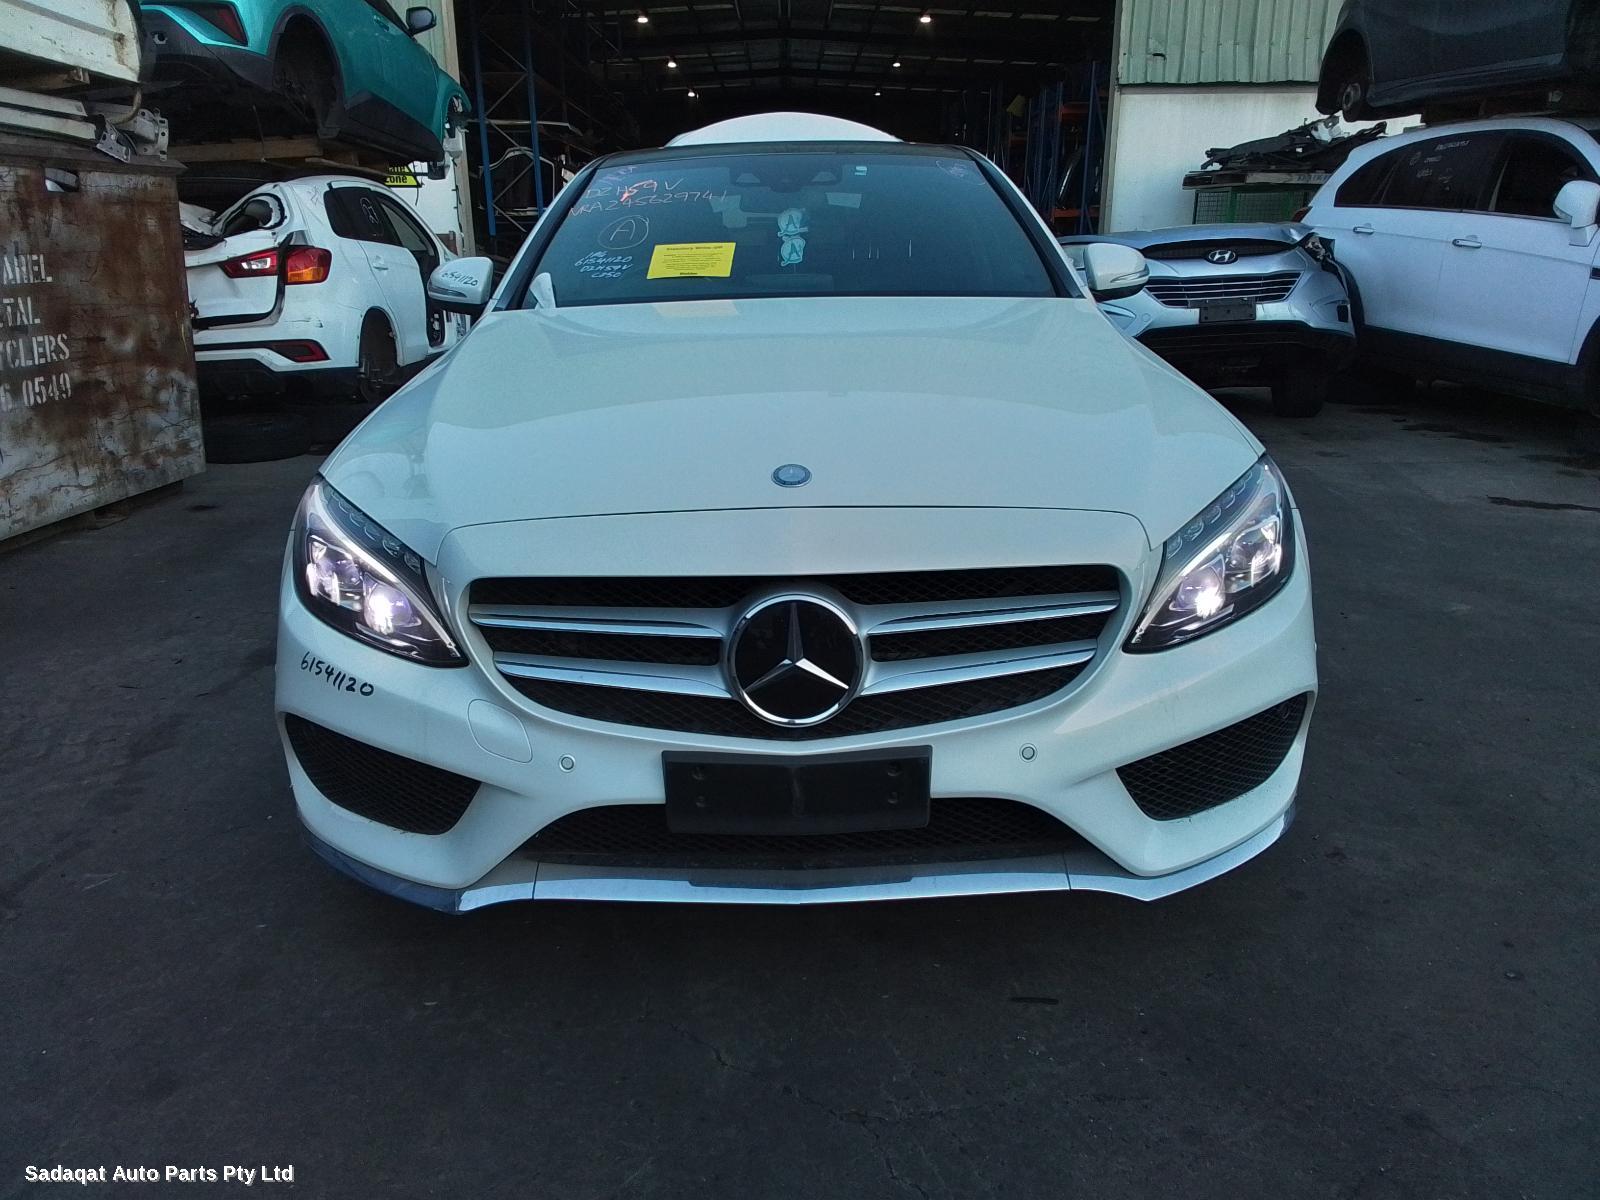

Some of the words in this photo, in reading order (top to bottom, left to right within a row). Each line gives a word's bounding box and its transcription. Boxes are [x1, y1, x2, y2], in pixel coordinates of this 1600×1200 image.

[610, 219, 636, 241] A
[0, 333, 70, 369] CLERS
[22, 372, 72, 407] 0549
[300, 651, 374, 697] 61541120
